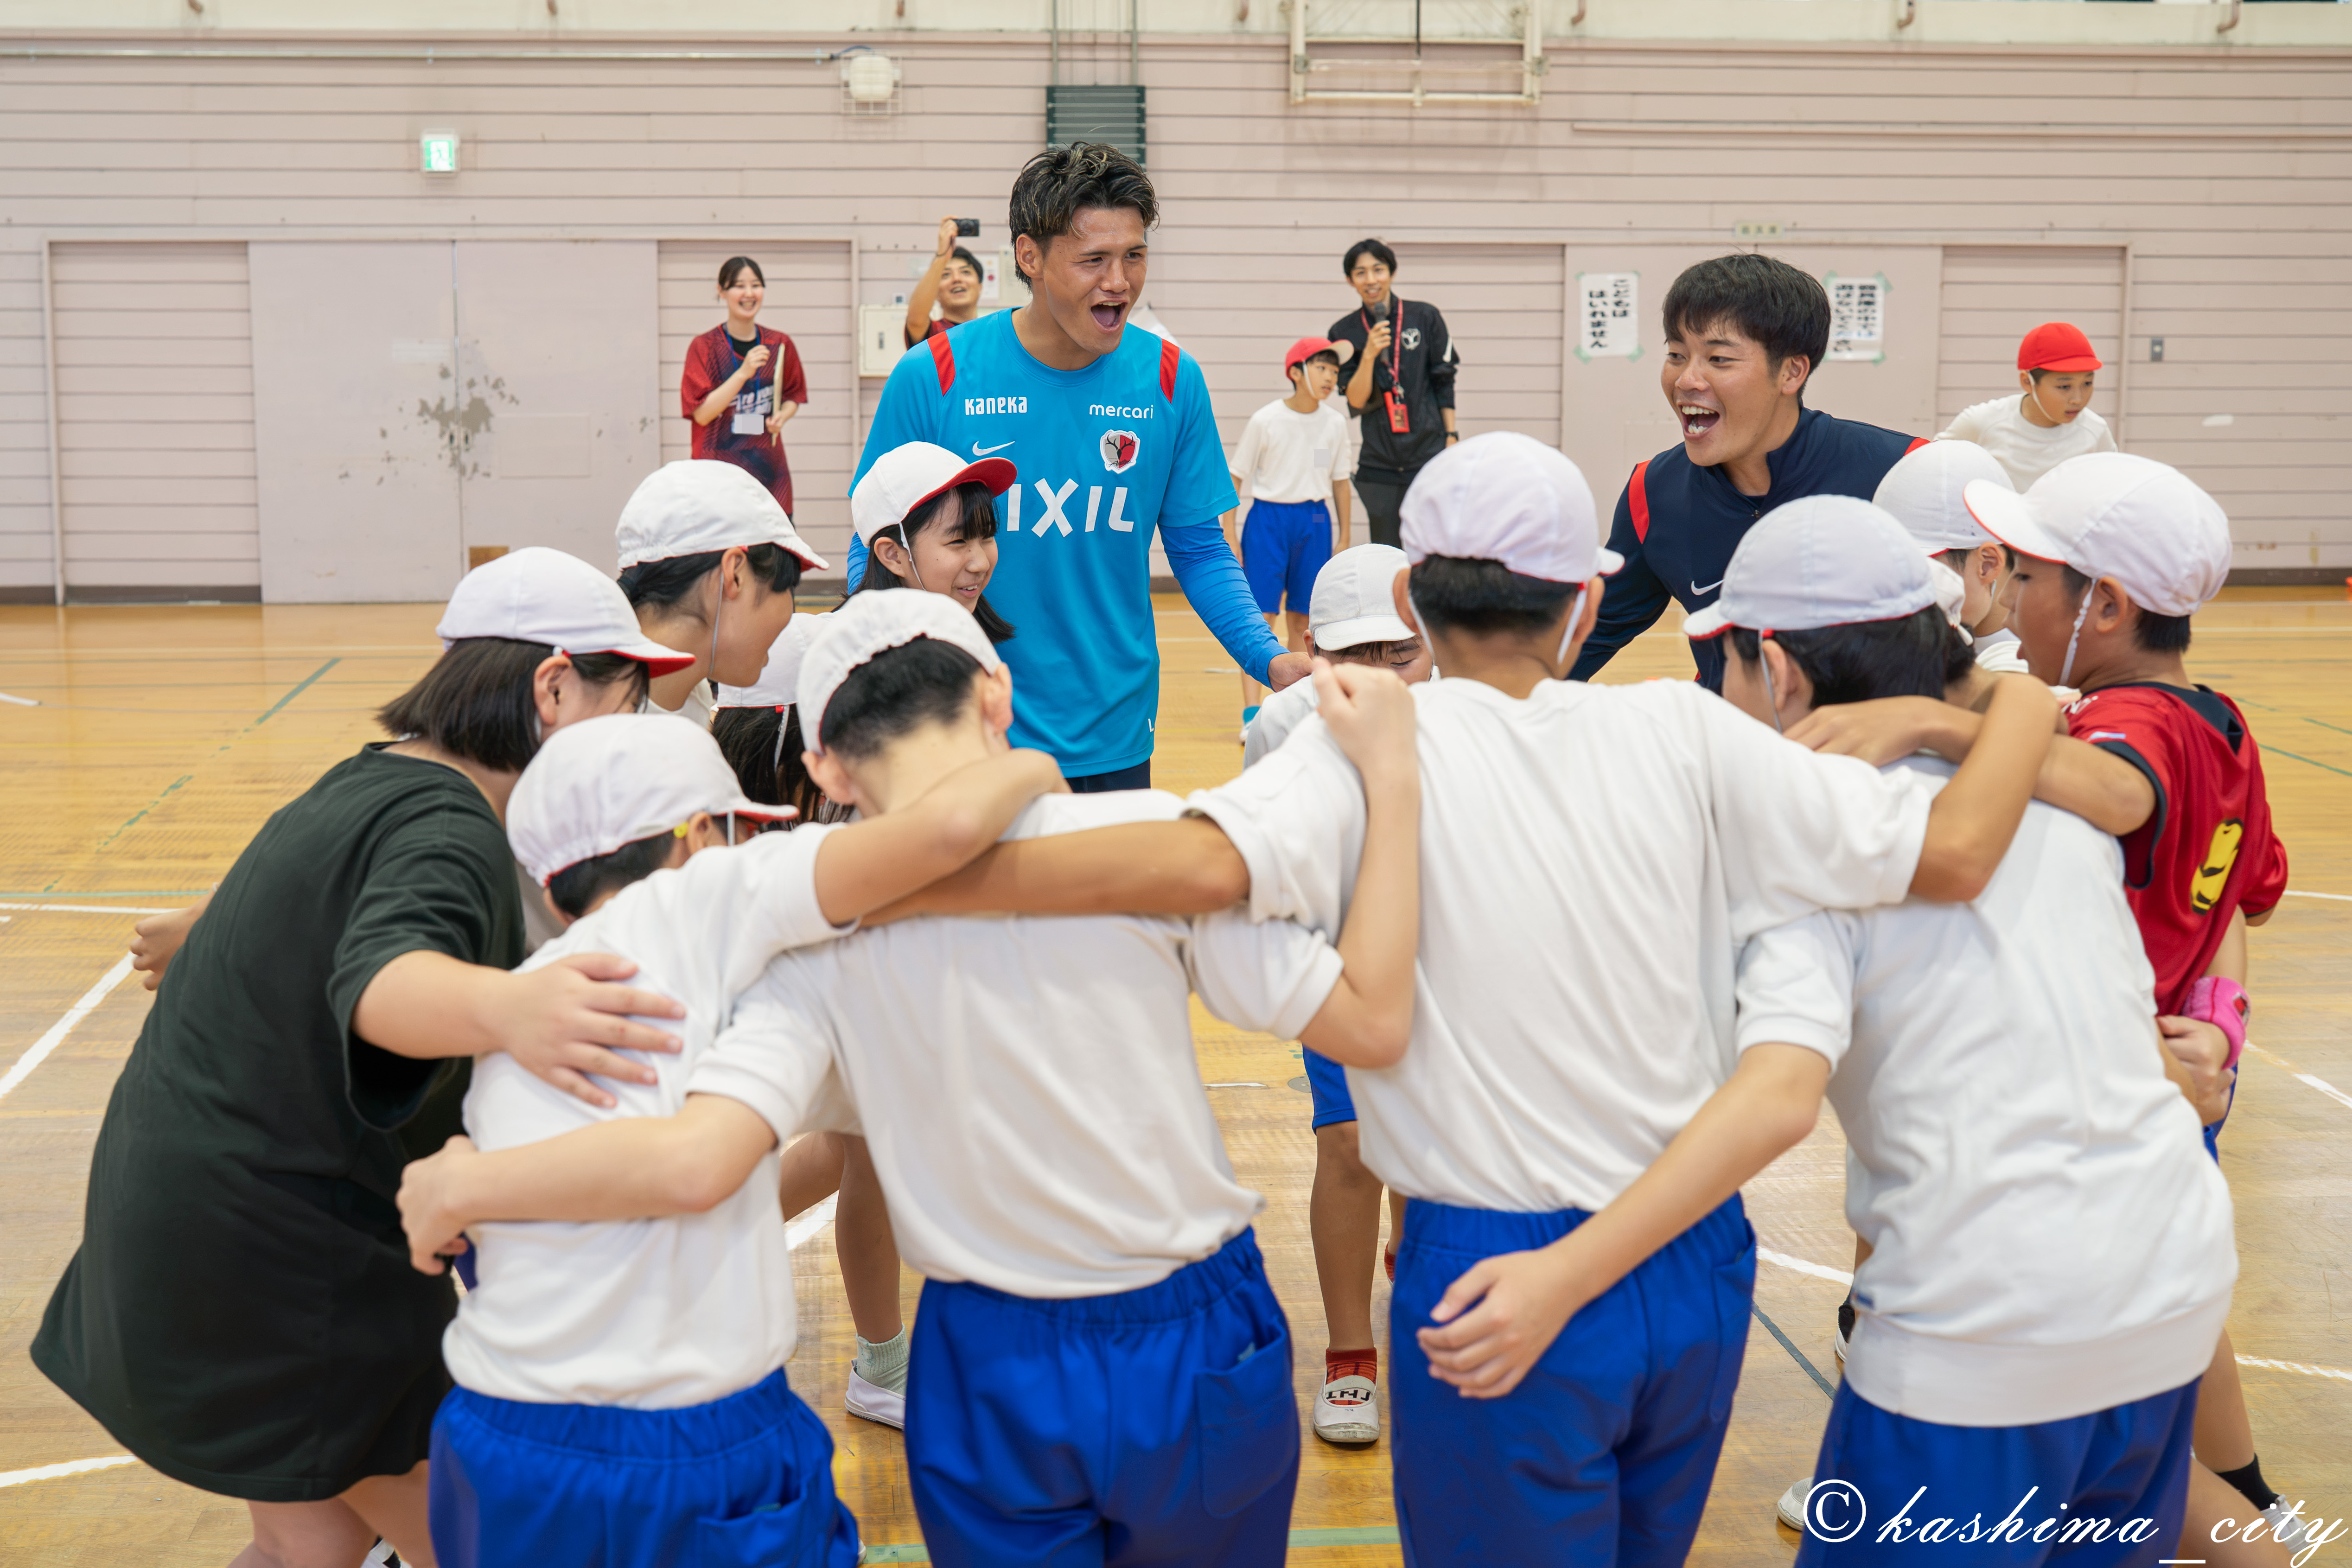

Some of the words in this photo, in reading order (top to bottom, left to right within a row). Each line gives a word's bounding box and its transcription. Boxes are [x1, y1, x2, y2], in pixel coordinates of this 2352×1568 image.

[1589, 290, 1607, 348] はいれません
[1089, 404, 1154, 419] mercari
[1007, 478, 1134, 538] IXIL
